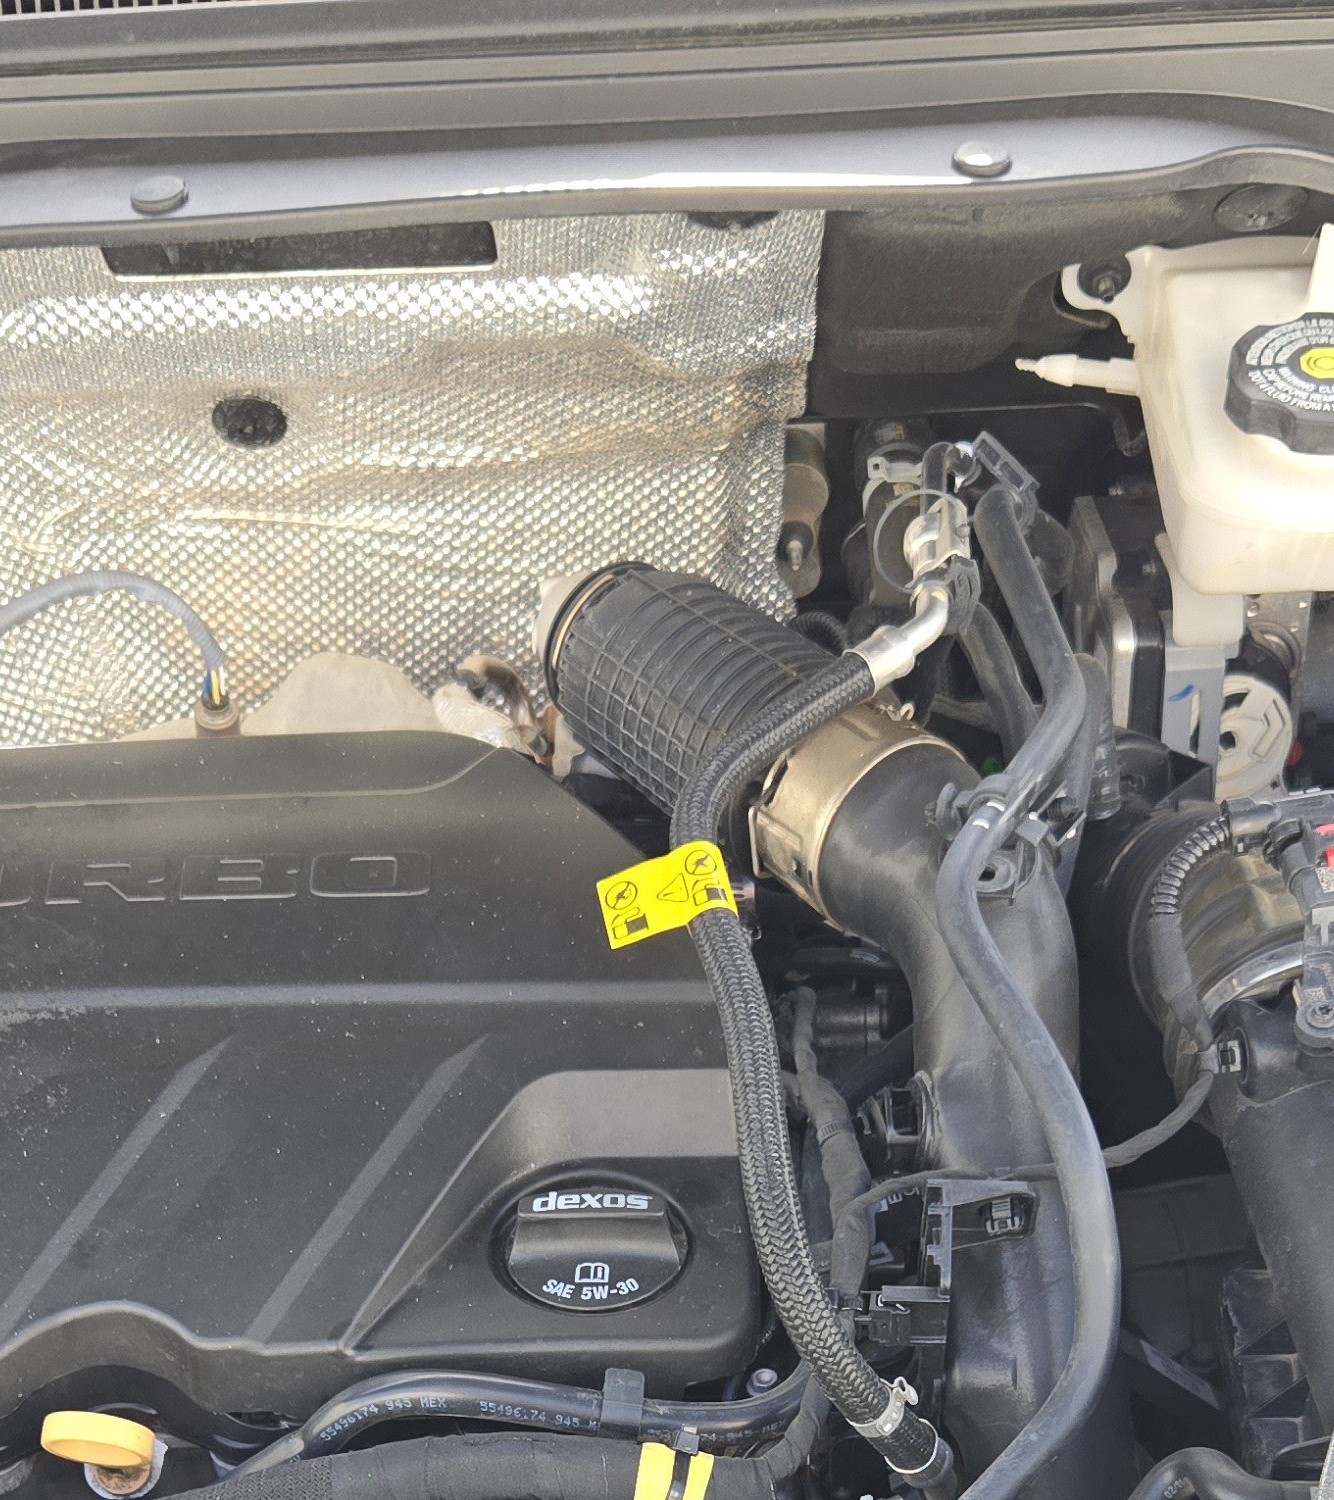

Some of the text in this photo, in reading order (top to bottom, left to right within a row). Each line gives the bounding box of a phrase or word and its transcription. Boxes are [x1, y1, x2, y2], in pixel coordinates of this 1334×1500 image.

[533, 1191, 653, 1213] dexos
[542, 1277, 640, 1300] SAE 5W-30
[385, 1399, 413, 1411] 945
[420, 1396, 448, 1409] MEX
[554, 1414, 581, 1428] 945
